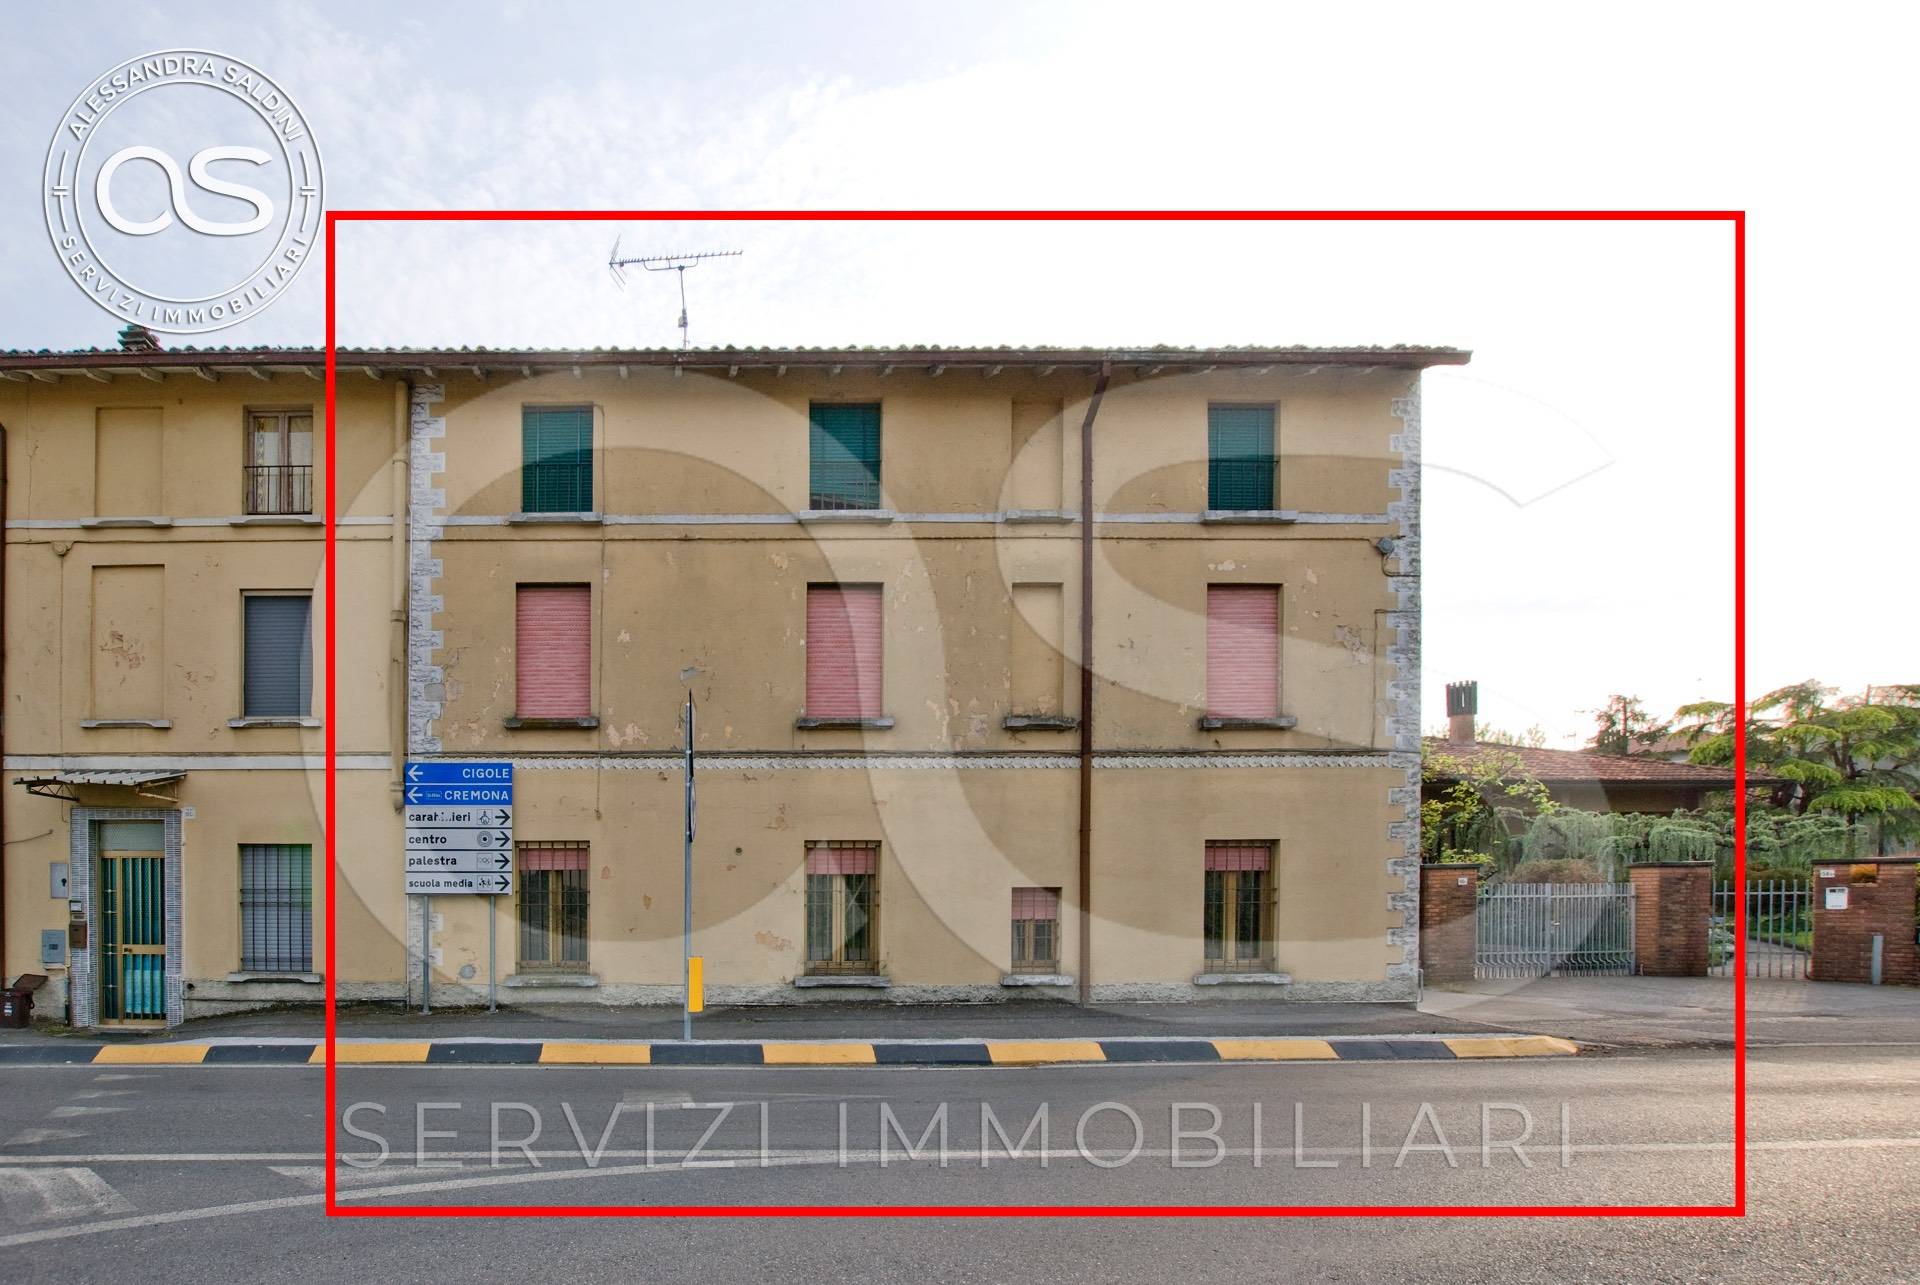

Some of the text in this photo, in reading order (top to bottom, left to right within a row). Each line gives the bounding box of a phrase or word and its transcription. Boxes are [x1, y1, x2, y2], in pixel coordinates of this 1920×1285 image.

[462, 768, 510, 779] CIGOLE
[444, 790, 509, 801] CREMONA
[408, 834, 448, 844] centro
[408, 856, 457, 866] palestra
[408, 878, 473, 888] scuola media
